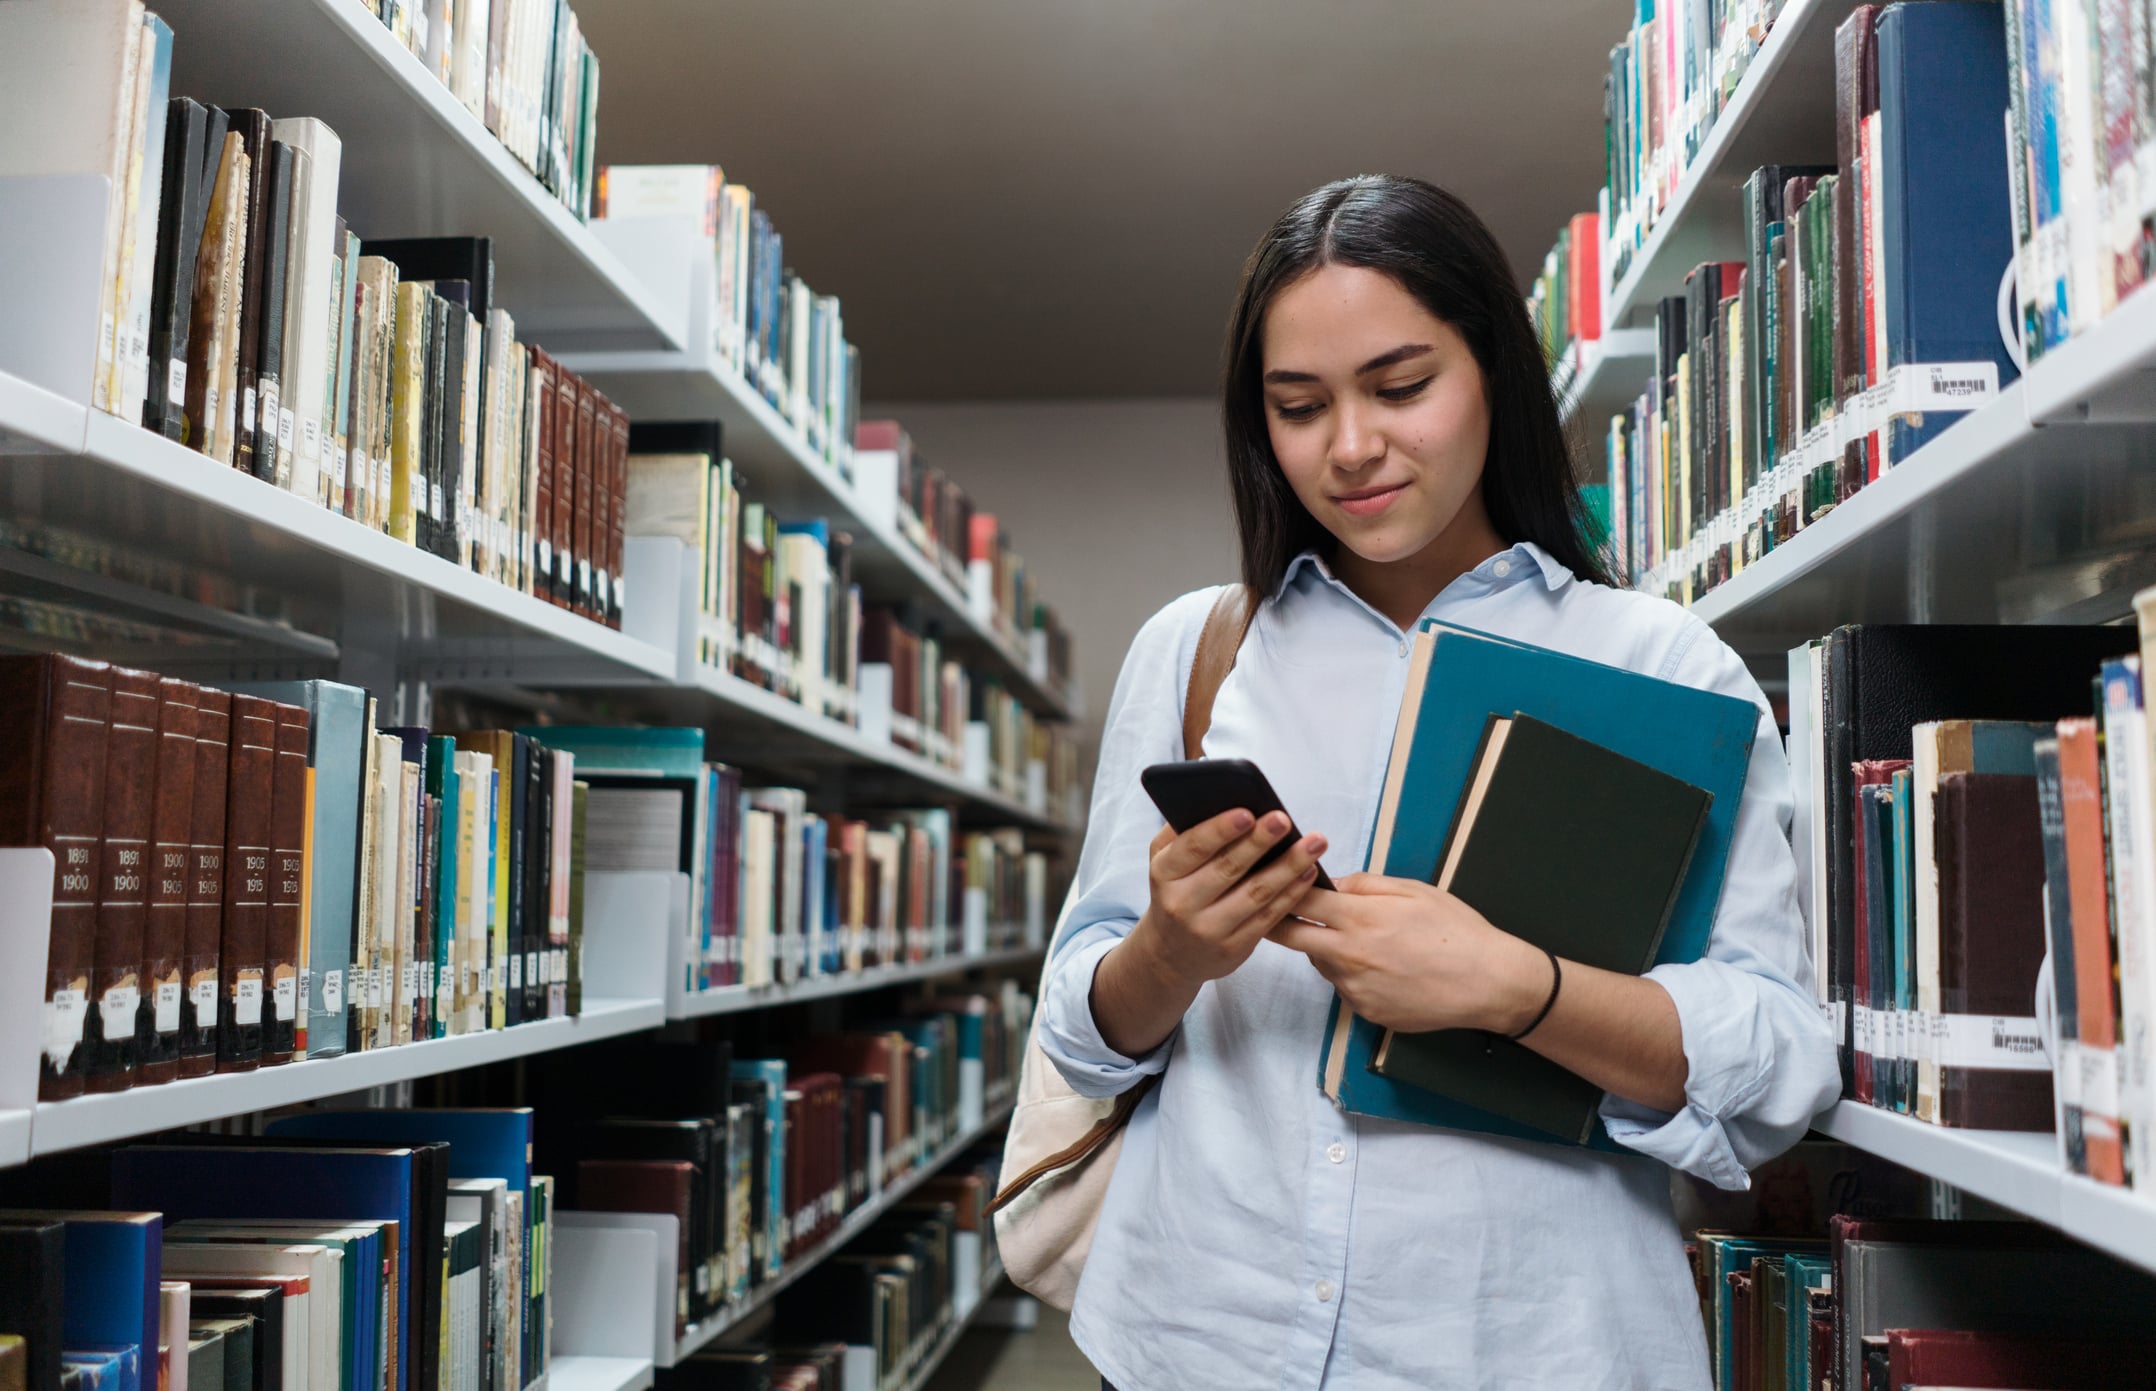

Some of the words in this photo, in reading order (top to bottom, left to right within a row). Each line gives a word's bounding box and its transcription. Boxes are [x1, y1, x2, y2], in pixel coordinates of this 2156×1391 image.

[67, 848, 89, 865] 1891
[119, 849, 140, 866] 1891
[163, 853, 184, 868] 1900
[199, 854, 219, 869] 1900
[245, 856, 266, 870] 1905
[282, 858, 300, 872] 1905
[62, 875, 89, 891] 1900
[114, 875, 140, 891] 1900
[162, 880, 182, 894] 1905
[198, 880, 217, 894] 1905
[246, 878, 264, 893] 1915
[282, 879, 298, 893] 1915
